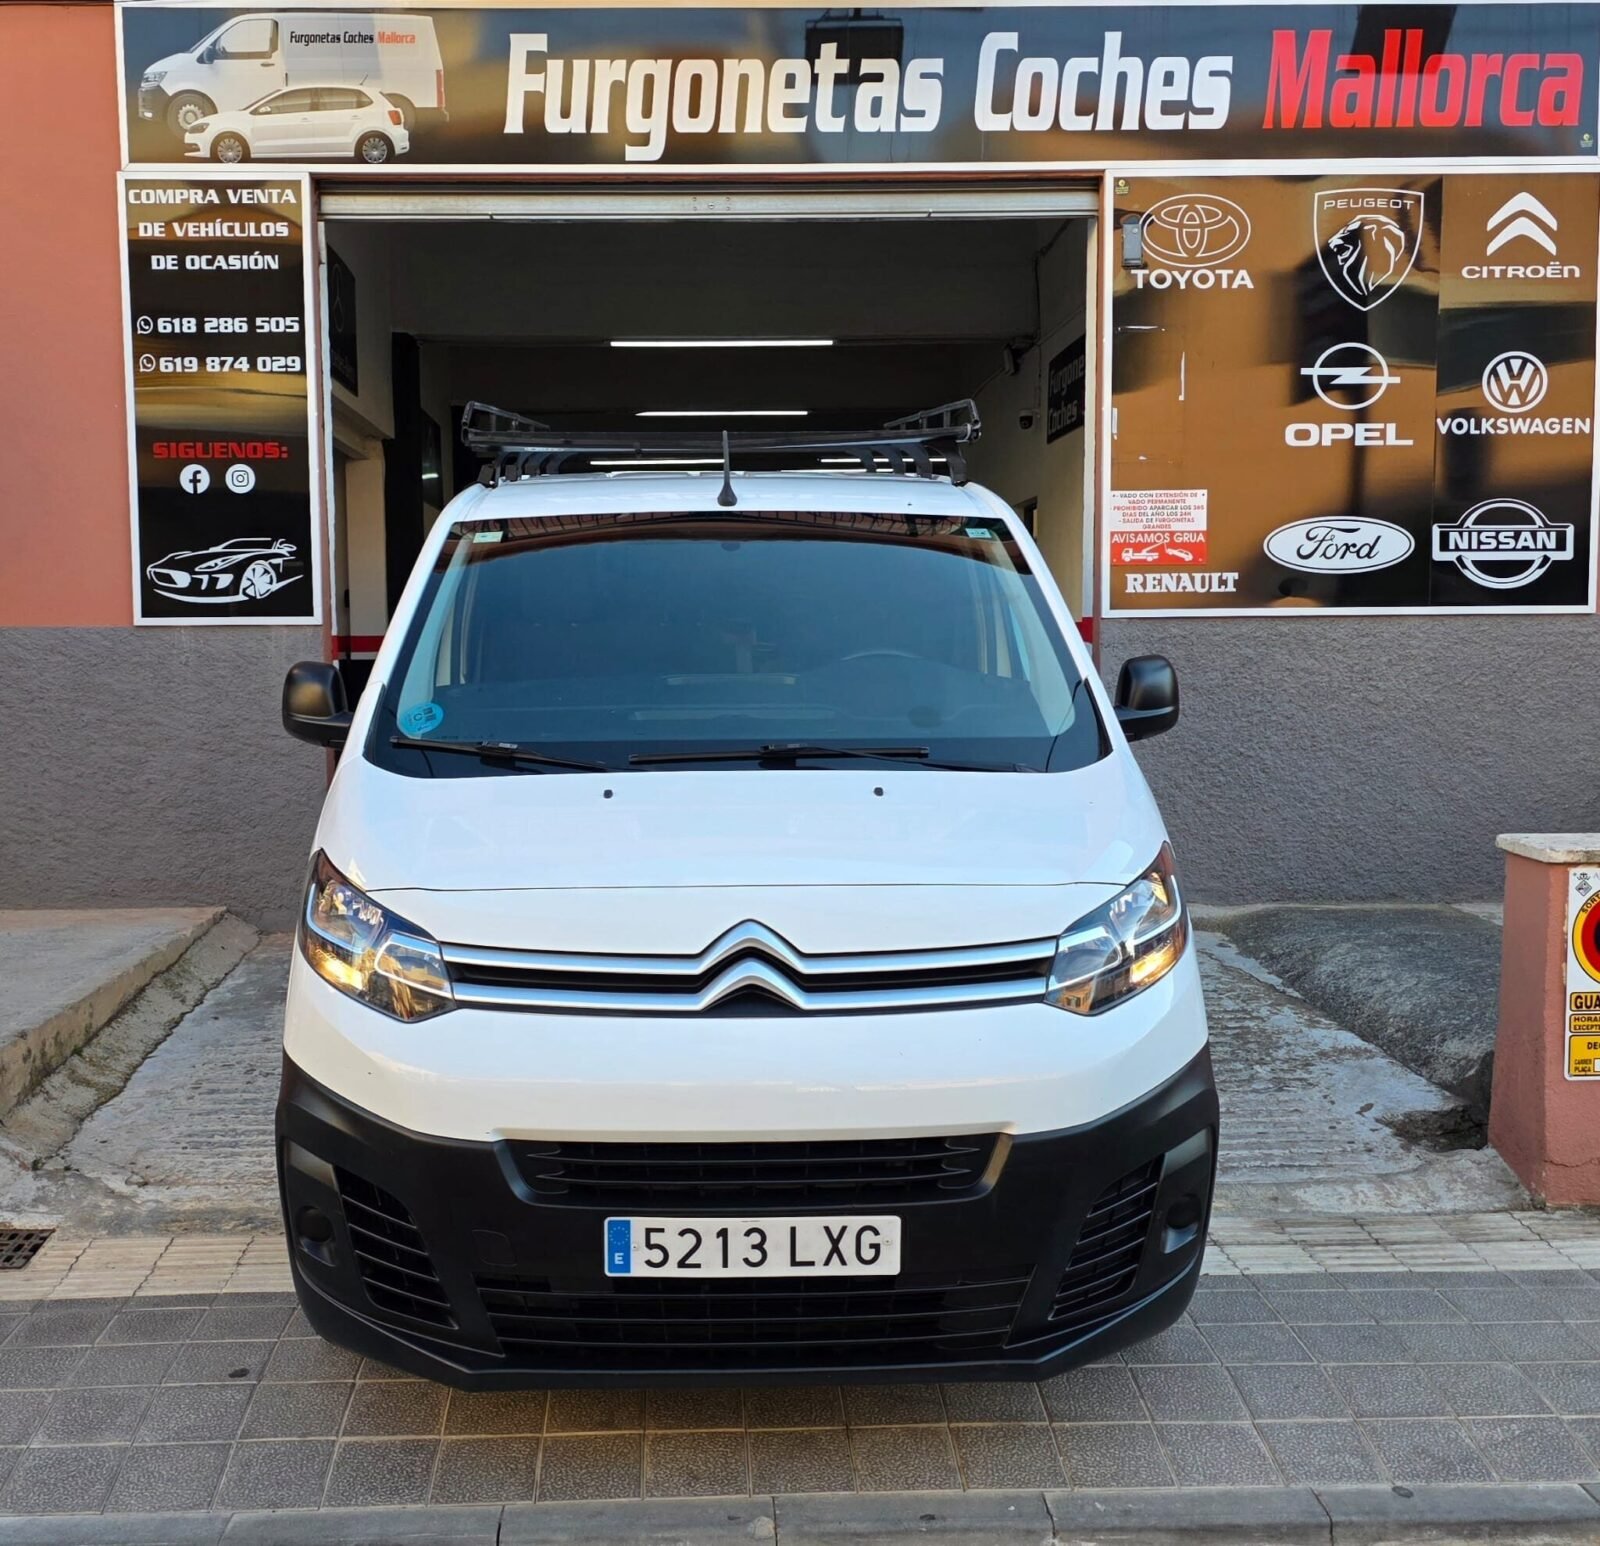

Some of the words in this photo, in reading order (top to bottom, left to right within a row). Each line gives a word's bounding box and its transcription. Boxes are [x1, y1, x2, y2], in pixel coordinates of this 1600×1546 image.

[290, 31, 341, 46] Furgonetas
[343, 31, 374, 43] Coches
[377, 32, 416, 44] Mallorca
[504, 33, 943, 162] Furgonetas
[974, 31, 1233, 132] Coches
[1264, 29, 1584, 130] Mallorca
[128, 189, 220, 204] COMPRA
[226, 189, 297, 204] VENTA
[1323, 198, 1414, 210] PEUGEOT
[138, 222, 166, 237] DE
[173, 219, 289, 237] VEHÍCULOS
[151, 255, 179, 270] DE
[185, 251, 279, 270] OCASIÓN
[1131, 269, 1254, 289] TOYOTA
[157, 317, 197, 333] 618
[204, 317, 248, 333] 286
[255, 317, 300, 333] 505
[159, 356, 199, 372] 619
[206, 356, 250, 372] 874
[257, 356, 301, 372] 029
[1285, 423, 1413, 446] OPEL
[1436, 417, 1590, 436] VOLKSWAGEN
[153, 442, 289, 459] SIGUENOS:
[1112, 532, 1170, 543] AVISAMOS
[1173, 532, 1206, 542] GRUA
[1296, 525, 1381, 562] Ford
[1448, 532, 1556, 550] NISSAN
[1125, 571, 1239, 593] RENAULT
[644, 1227, 769, 1269] 5213
[790, 1225, 881, 1267] LXG
[614, 1253, 624, 1265] E
